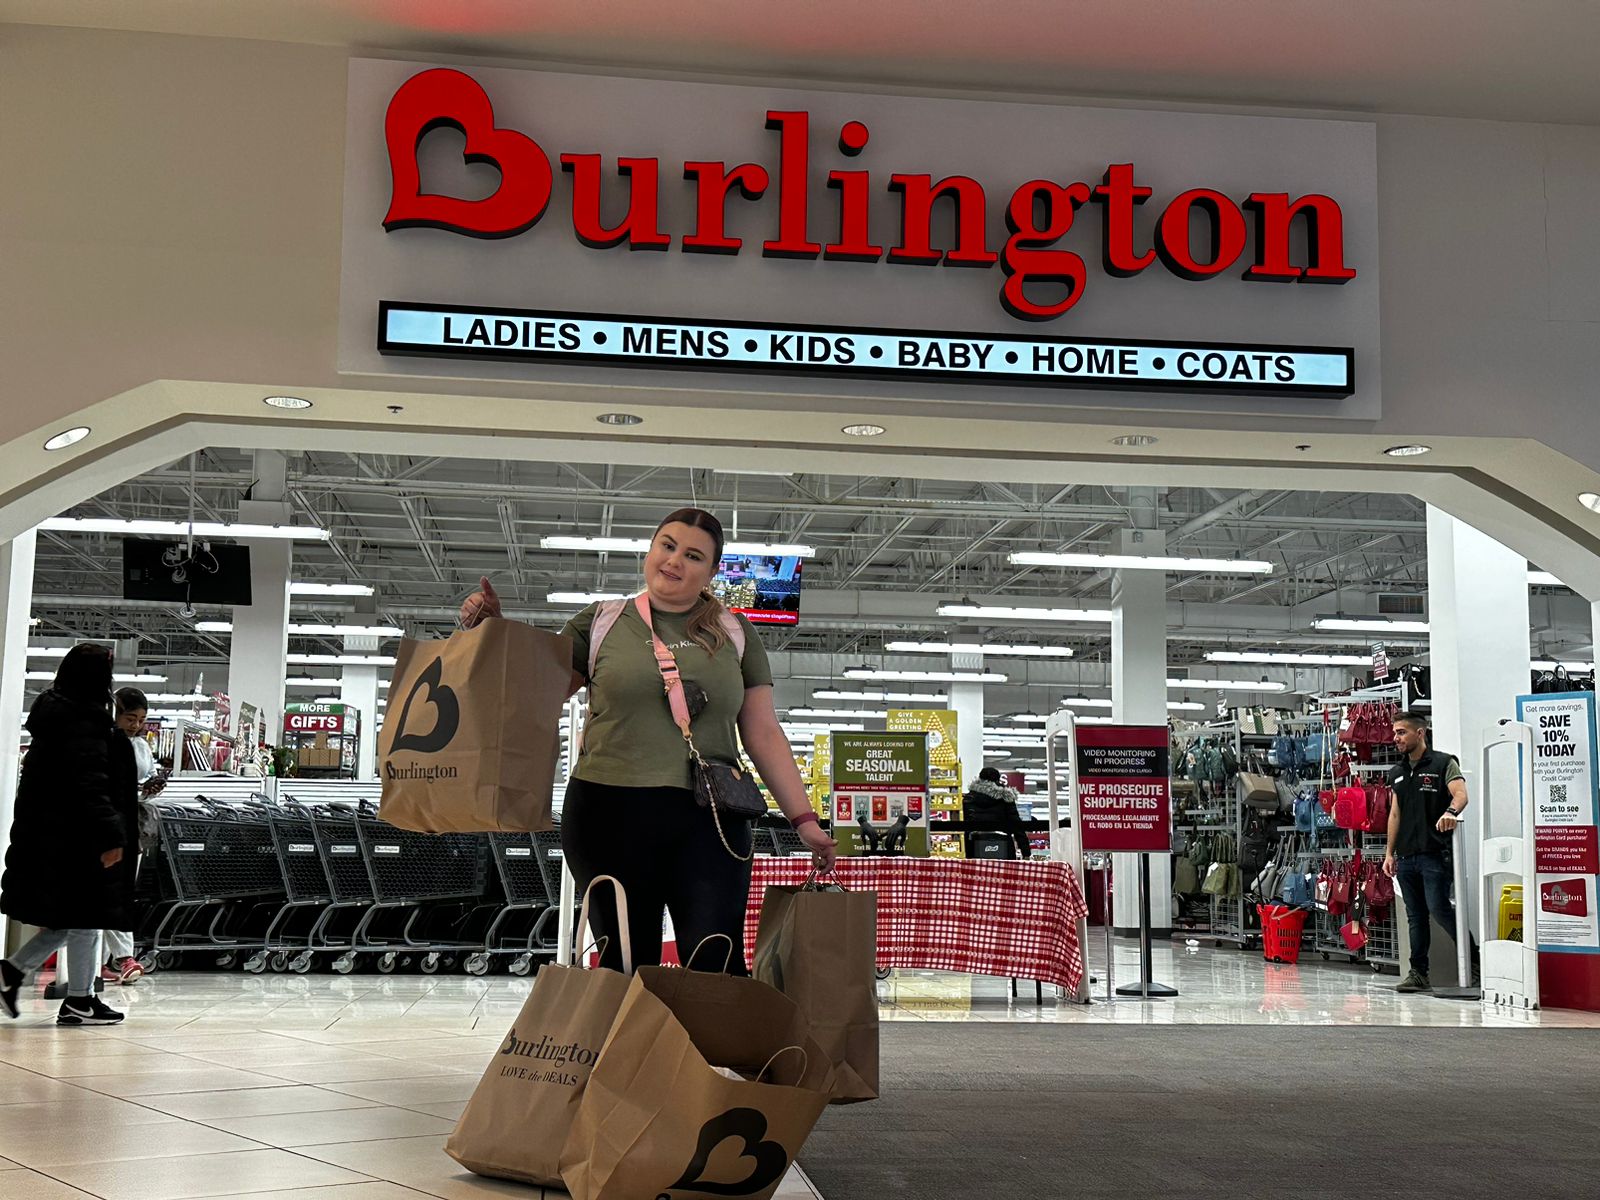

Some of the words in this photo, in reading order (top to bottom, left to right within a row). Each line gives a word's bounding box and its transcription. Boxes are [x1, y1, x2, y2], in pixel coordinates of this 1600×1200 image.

[383, 68, 1356, 321] Burlington
[443, 317, 581, 350] LADIES
[622, 327, 730, 358] MENS
[769, 334, 856, 364] KIDS
[898, 340, 994, 370] BABY
[1032, 346, 1139, 376] HOME
[1176, 352, 1296, 382] COATS
[299, 704, 331, 712] MORE
[1526, 705, 1538, 713] Get
[1539, 705, 1556, 713] more
[290, 715, 338, 729] GIFTS
[1539, 714, 1571, 728] SAVE
[1542, 729, 1569, 743] 10%
[866, 749, 893, 759] GREAT
[1083, 749, 1106, 757] VIDEO
[1107, 749, 1157, 758] MONITORING
[1536, 743, 1576, 758] TODAY
[845, 758, 914, 773] SEASONAL
[1103, 758, 1146, 766] PROGRESS
[386, 760, 458, 784] Burlington
[865, 773, 894, 782] TALENT
[1078, 783, 1096, 795] WE
[1098, 784, 1164, 796] PROSECUTE
[1083, 797, 1158, 809] SHOPLIFTERS
[1539, 804, 1557, 813] Scan
[1122, 814, 1160, 822] LEGALMENTE
[1132, 822, 1154, 830] TIENDA
[1509, 913, 1522, 921] CAUT
[500, 1065, 528, 1079] LOVE
[528, 1070, 542, 1081] the
[542, 1070, 579, 1087] DEALS
